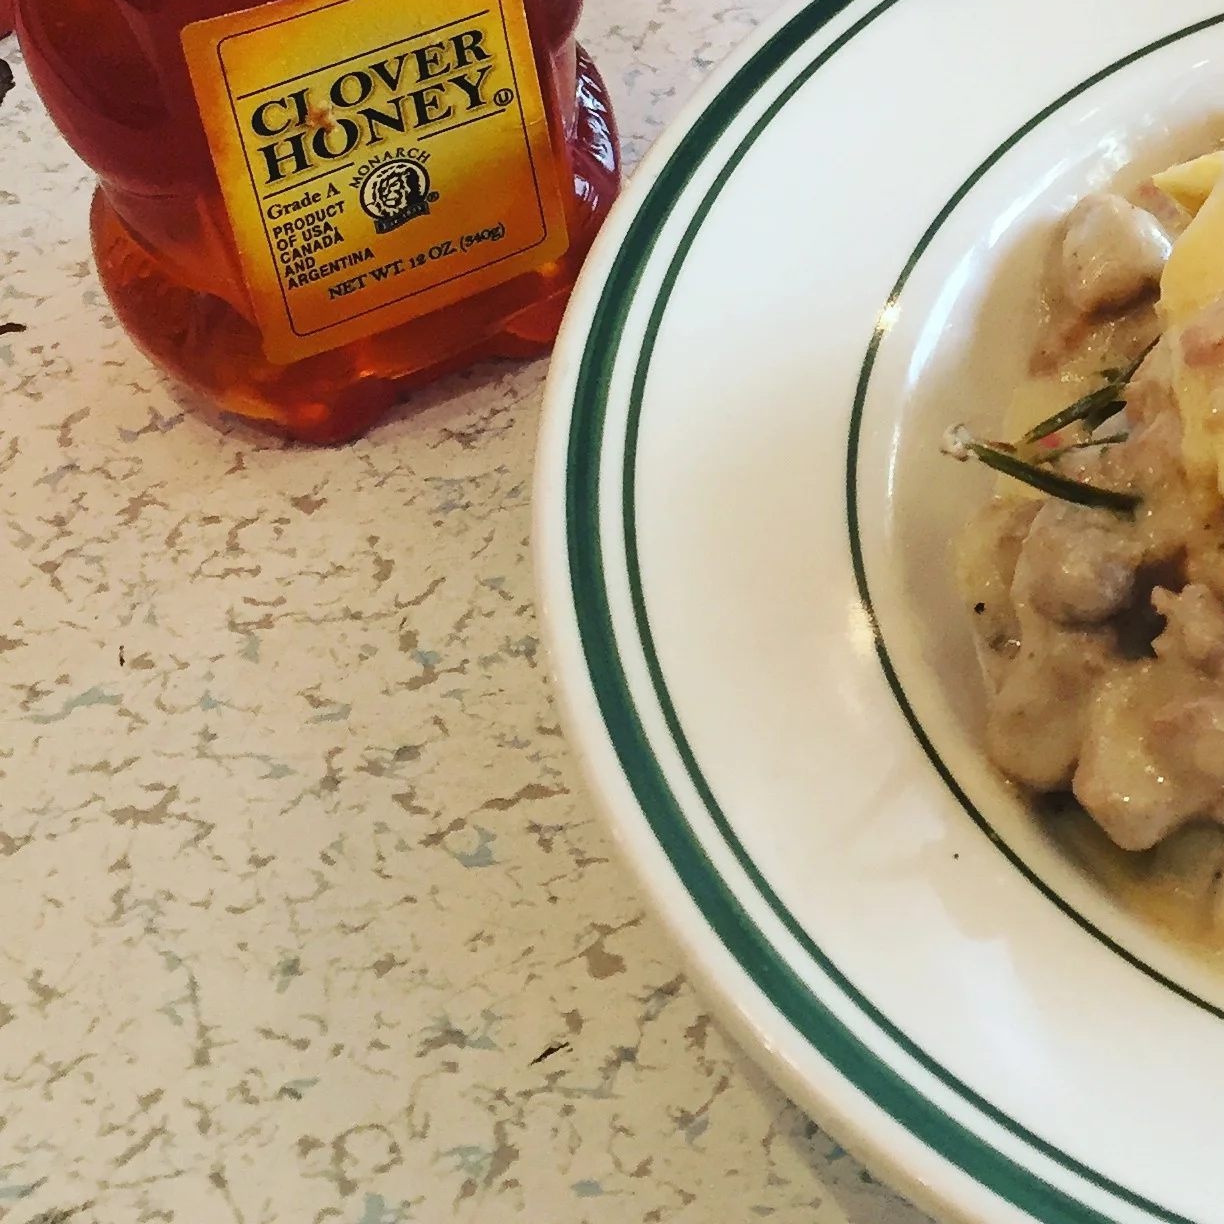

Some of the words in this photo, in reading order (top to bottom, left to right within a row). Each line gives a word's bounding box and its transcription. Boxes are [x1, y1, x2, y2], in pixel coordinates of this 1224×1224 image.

[251, 29, 490, 137] CLOVER
[258, 65, 493, 184] HONEY
[349, 147, 431, 189] MONARCH
[267, 192, 321, 220] Grade
[326, 182, 341, 199] A
[272, 200, 345, 239] PRODUCT
[276, 235, 297, 251] OF
[280, 228, 345, 264] CANADA
[328, 273, 367, 300] NET
[409, 253, 427, 269] 12
[459, 222, 506, 253] (340g)
[285, 256, 315, 278] AND
[288, 247, 375, 290] ARGENTINA
